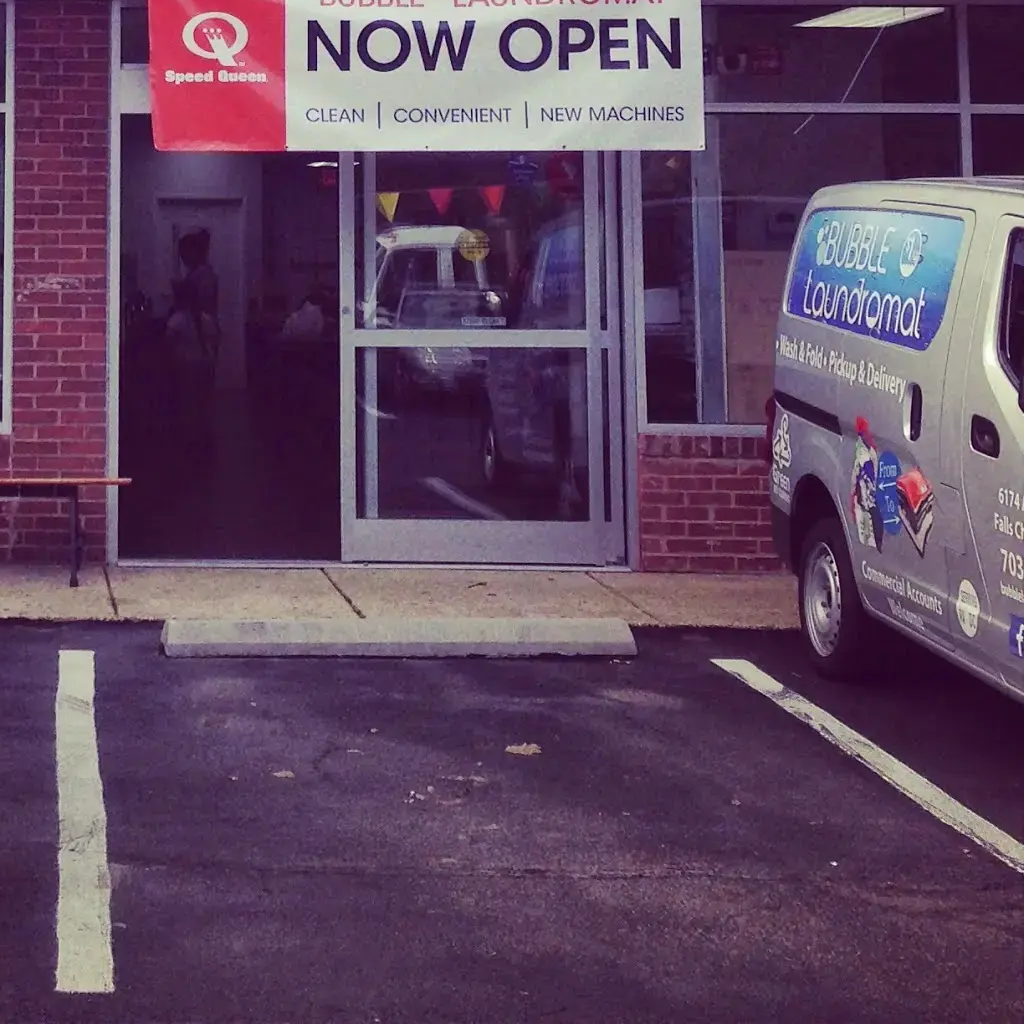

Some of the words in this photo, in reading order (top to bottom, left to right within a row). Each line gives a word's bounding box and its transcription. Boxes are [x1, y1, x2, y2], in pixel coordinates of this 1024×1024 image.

[306, 19, 475, 72] NOW
[499, 17, 682, 71] OPEN
[165, 70, 213, 85] Speed
[218, 70, 267, 83] Queen
[306, 107, 365, 123] CLEAN
[393, 107, 512, 124] CONVENIENT
[541, 106, 582, 123] NEW
[589, 105, 685, 123] MACHINES
[824, 220, 895, 275] BUBBLE
[803, 269, 925, 339] Laundromat
[780, 334, 797, 360] Wash
[799, 341, 807, 363] &
[807, 343, 824, 369] Fold
[828, 350, 857, 385] Pickup
[858, 360, 867, 384] &
[867, 362, 907, 404] Delivery
[879, 462, 897, 478] From
[885, 496, 895, 512] To
[998, 487, 1020, 511] 6174
[994, 512, 1013, 536] Falls
[1000, 548, 1024, 580] 703
[862, 560, 906, 596] Commercial
[907, 581, 943, 615] Accounts
